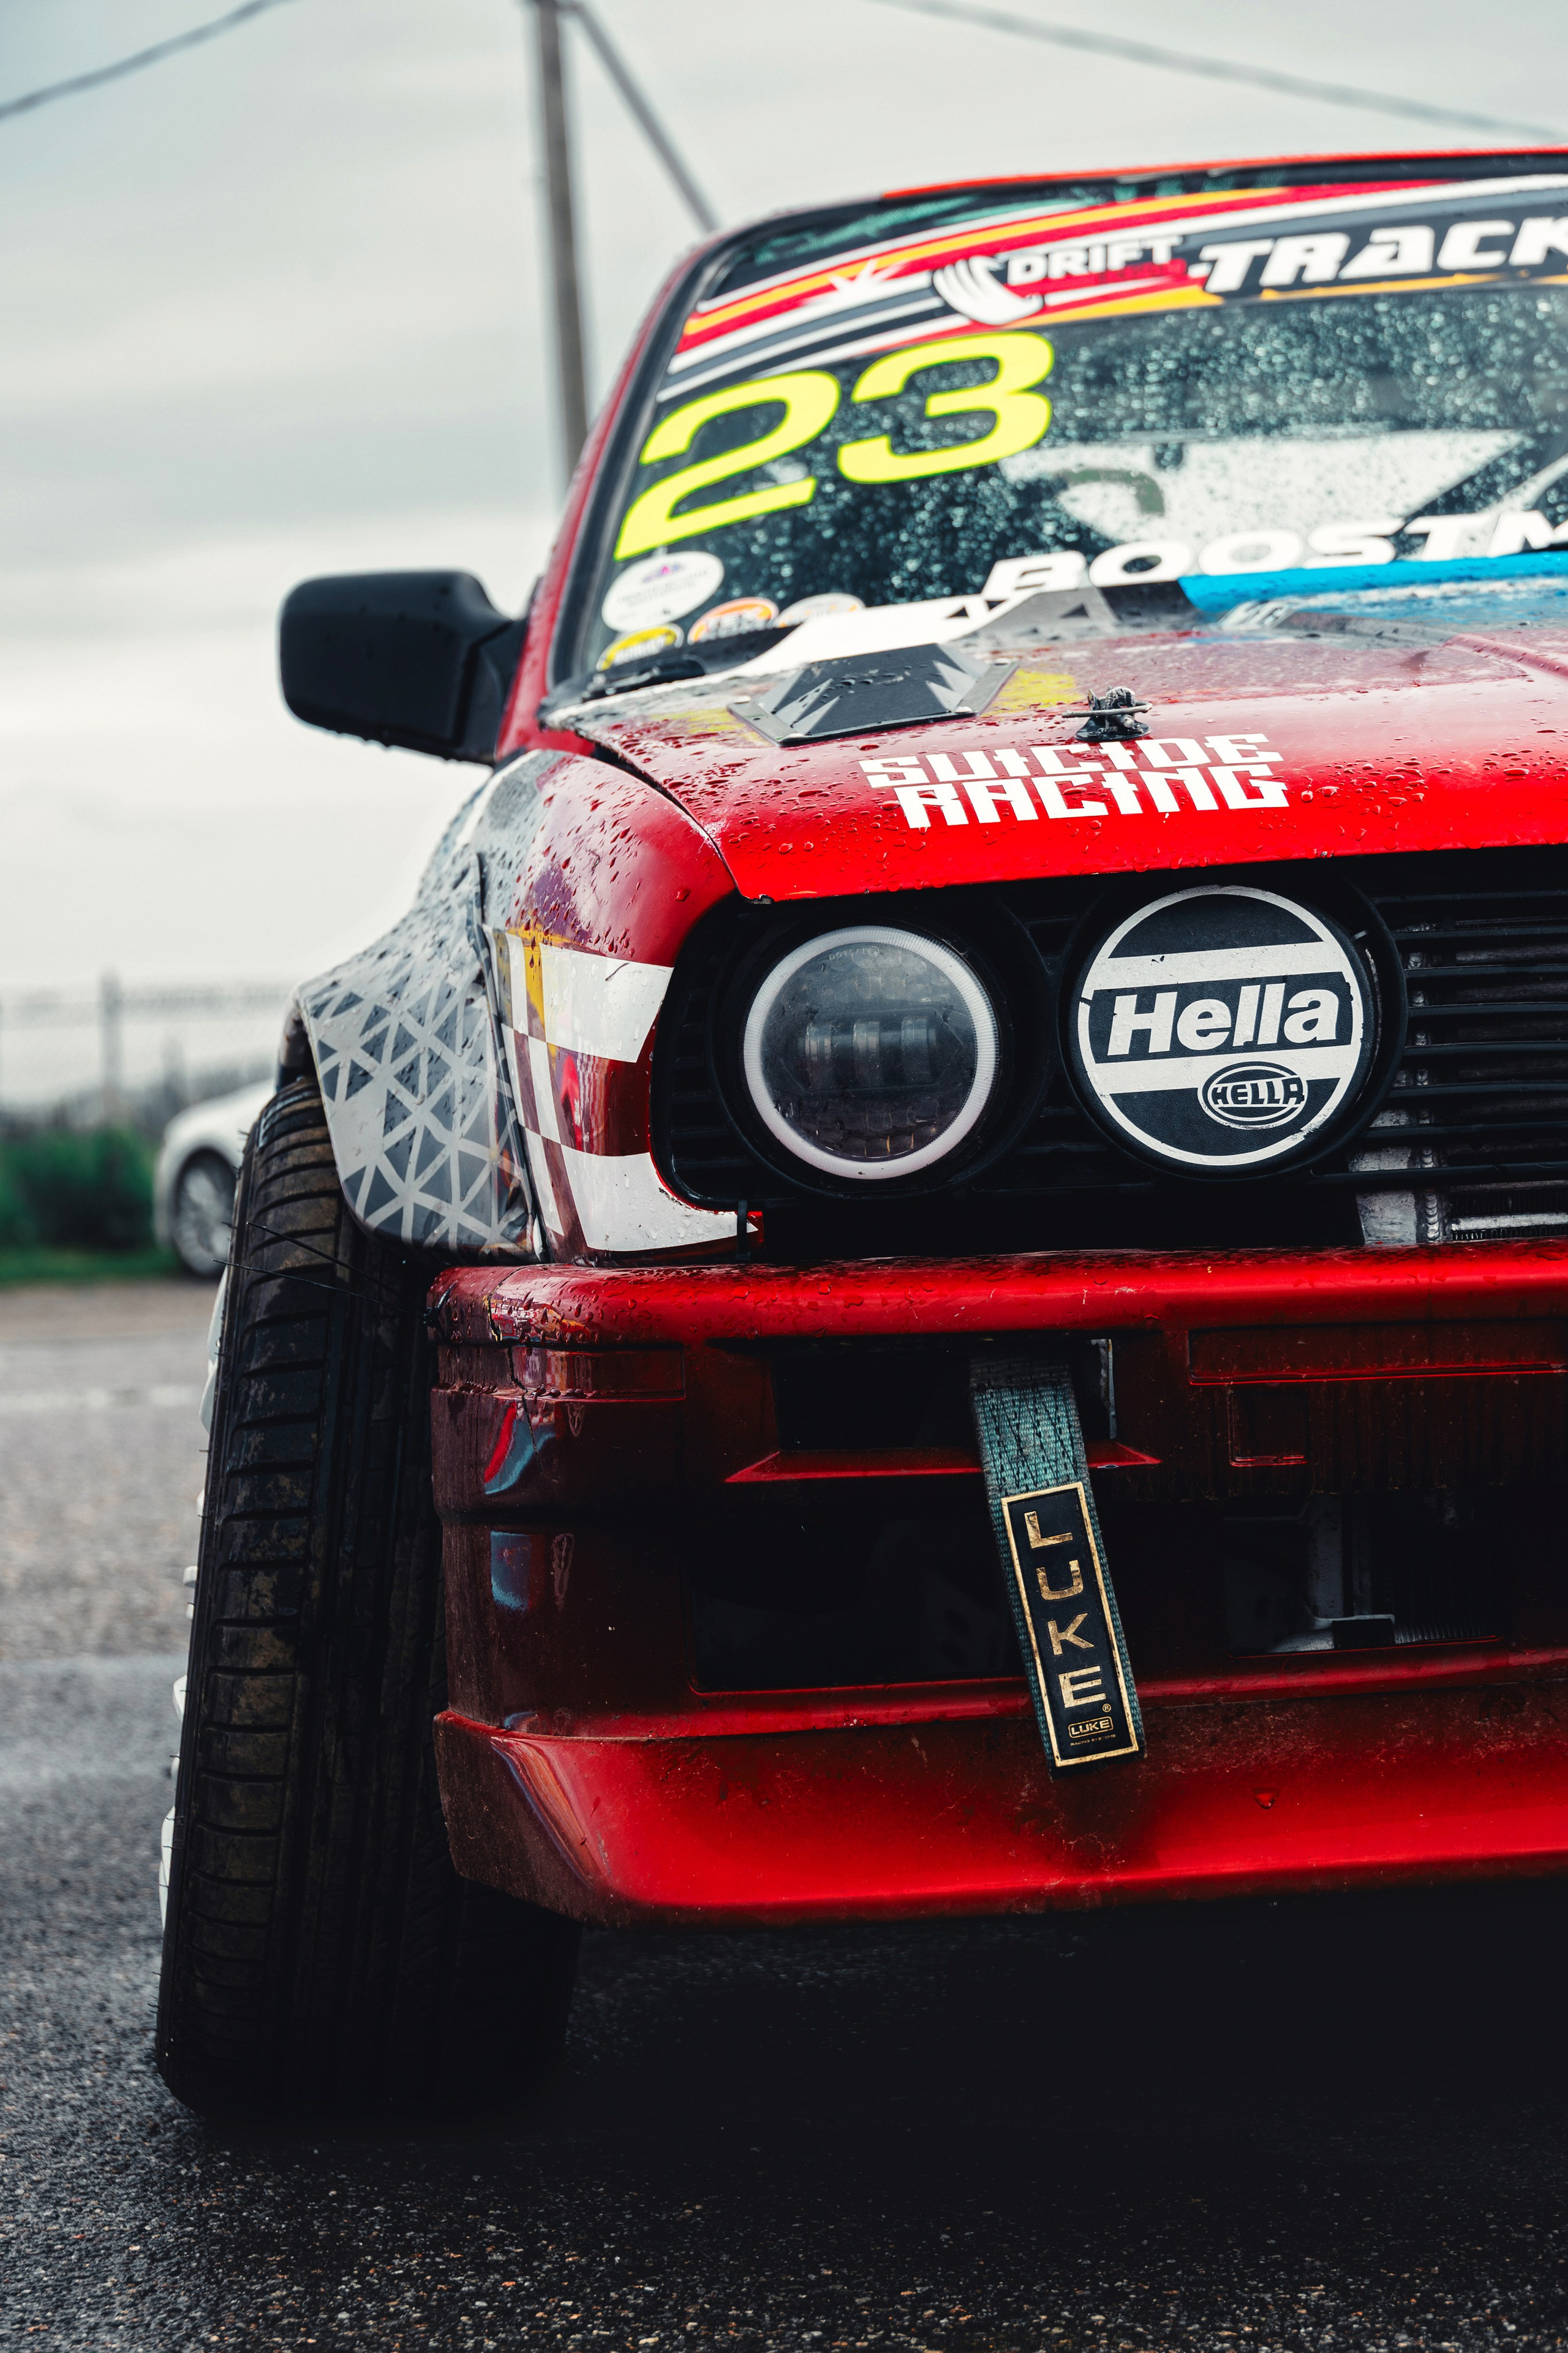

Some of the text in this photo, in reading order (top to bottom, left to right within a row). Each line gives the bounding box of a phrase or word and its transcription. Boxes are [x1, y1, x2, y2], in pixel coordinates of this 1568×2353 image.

[1007, 217, 1568, 292] DRIFT TRACK
[614, 331, 1055, 561] 23
[859, 733, 1284, 788] SUICIDE
[894, 764, 1289, 828] RACING
[1107, 983, 1339, 1056] Hella
[1211, 1077, 1305, 1105] HELLA
[1024, 1511, 1106, 1709] LUKE
[1071, 1720, 1110, 1735] LUKE
